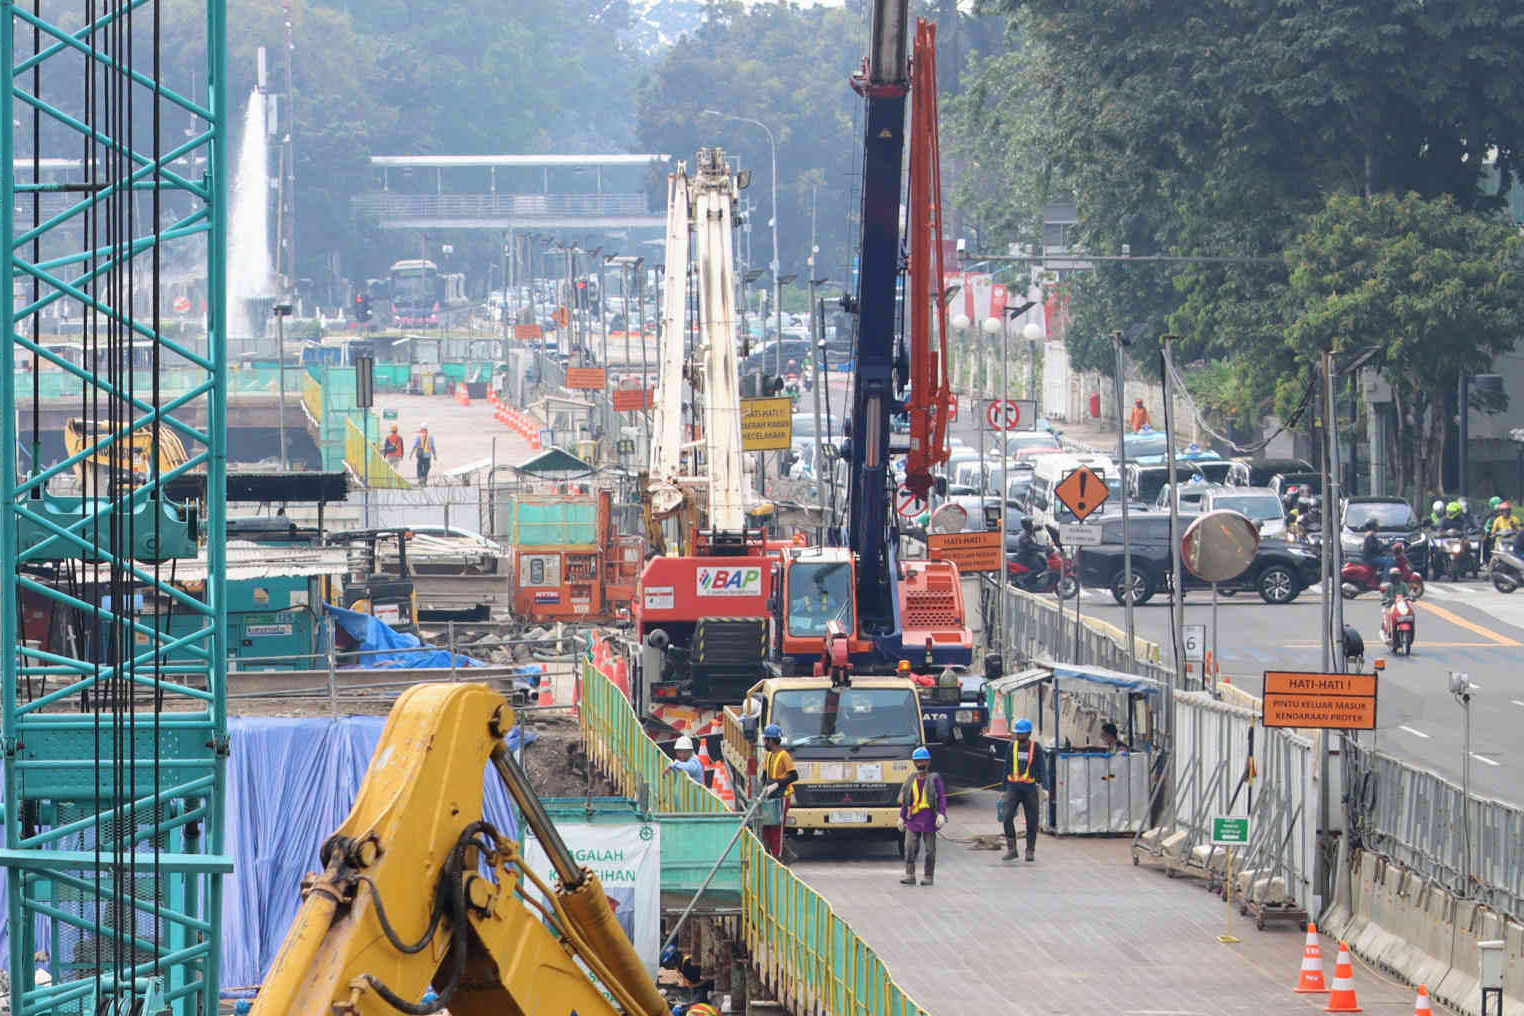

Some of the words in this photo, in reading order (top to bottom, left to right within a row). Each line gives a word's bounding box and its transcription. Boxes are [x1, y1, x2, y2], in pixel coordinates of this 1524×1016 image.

[711, 570, 759, 589] BAP
[1186, 636, 1196, 650] 6
[1289, 679, 1344, 690] HATI-HATI
[1272, 700, 1300, 708] PINTU
[1301, 701, 1333, 710] KELUAR
[1335, 702, 1366, 711] MASUK
[1275, 711, 1328, 720] KENDARAAN
[1330, 713, 1363, 722] PROYEK
